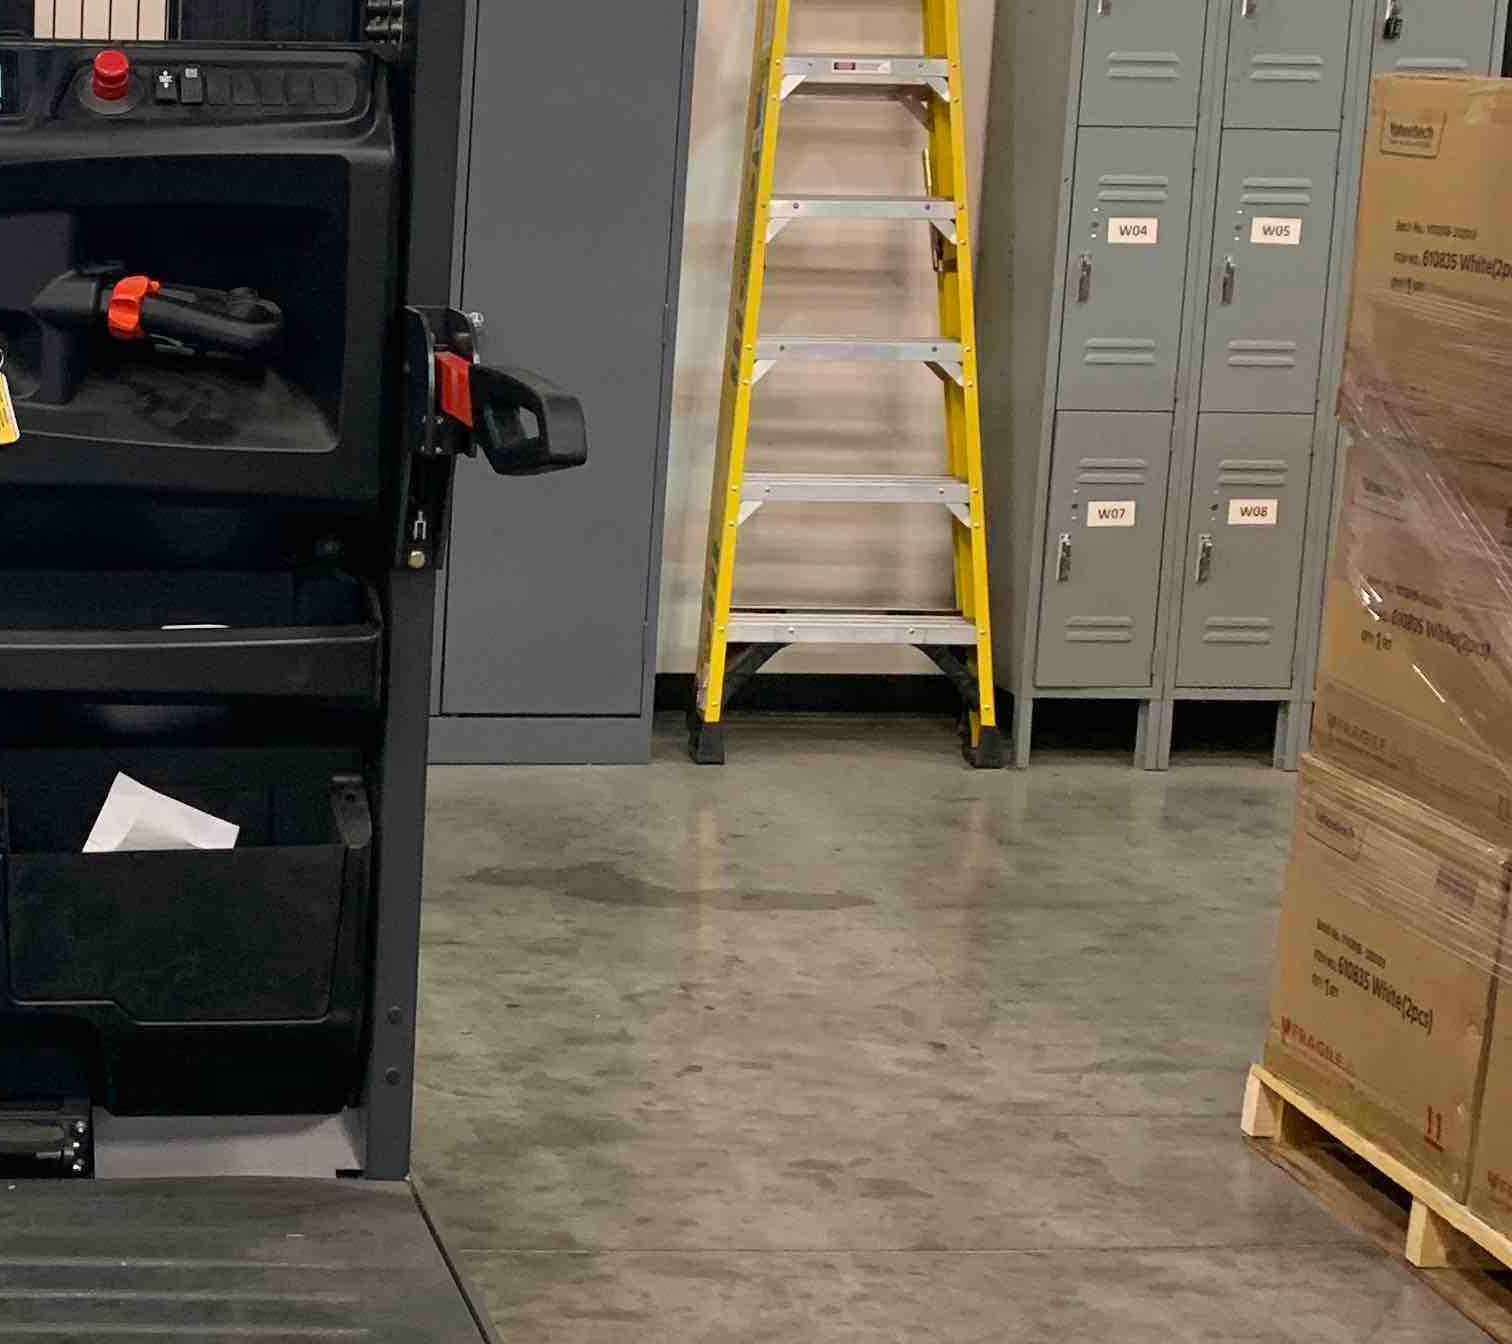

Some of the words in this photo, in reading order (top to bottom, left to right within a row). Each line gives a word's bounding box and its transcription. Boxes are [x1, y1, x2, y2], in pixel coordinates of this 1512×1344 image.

[1119, 225, 1148, 237] W04
[1262, 225, 1291, 237] W05
[1097, 507, 1126, 520] W07
[1372, 975, 1433, 1036] White(2pcs)
[1292, 1023, 1345, 1066] FRAGILE
